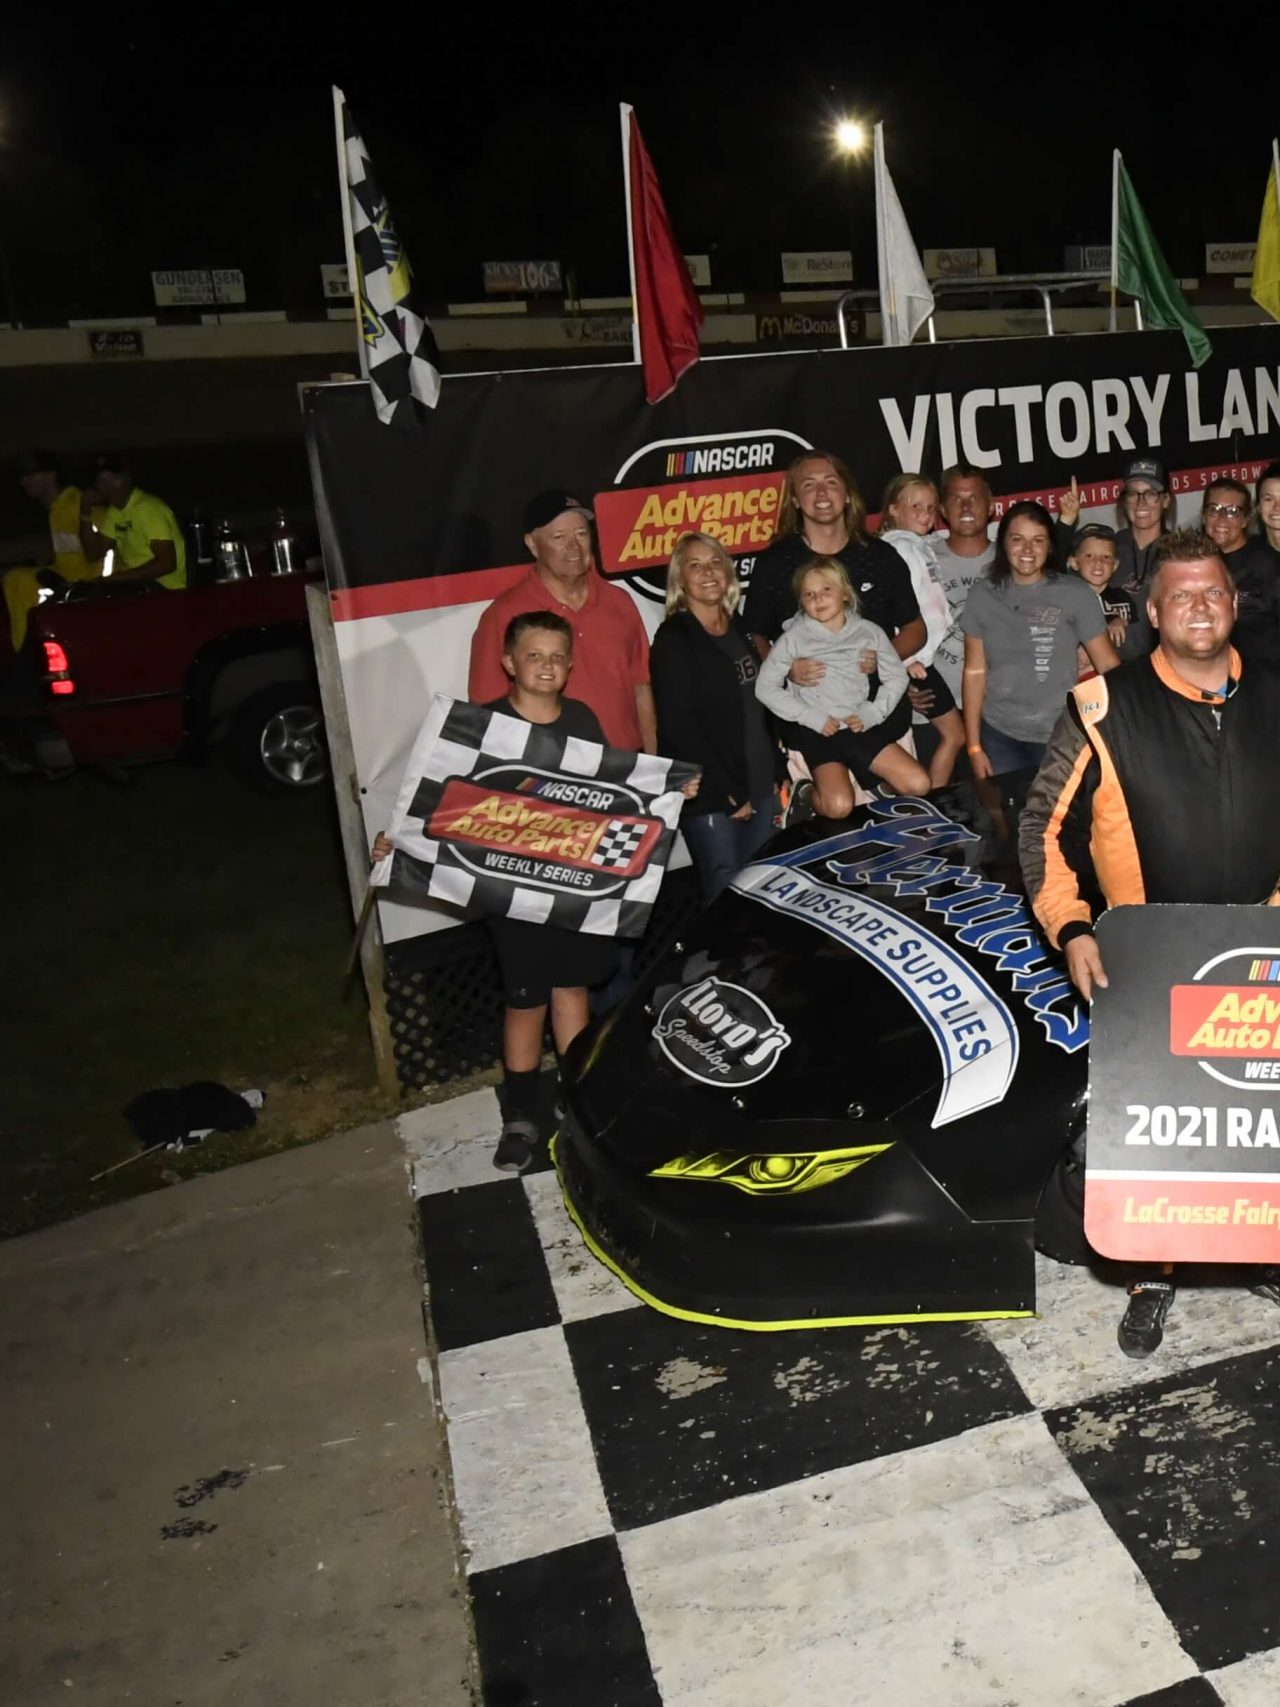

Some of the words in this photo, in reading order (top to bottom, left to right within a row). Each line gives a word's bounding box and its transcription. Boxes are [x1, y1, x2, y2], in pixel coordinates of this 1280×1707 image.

[878, 374, 1171, 473] VICTORY
[693, 442, 775, 474] NASCAR
[633, 485, 780, 531] Advance
[700, 517, 775, 548] Parts
[469, 795, 597, 838] Advance
[537, 780, 615, 810] NASCAR
[445, 815, 510, 846] Auto
[512, 828, 587, 860] Parts
[484, 852, 543, 876] WEEKLY
[542, 864, 594, 887] SERIES
[759, 872, 894, 947] LANDSCAPE
[887, 938, 991, 1061] SUPPLIES
[659, 1018, 732, 1075] Speedstop
[1187, 1021, 1271, 1050] Auto
[1124, 1104, 1217, 1147] 2021
[1122, 1197, 1228, 1225] LaCrosse
